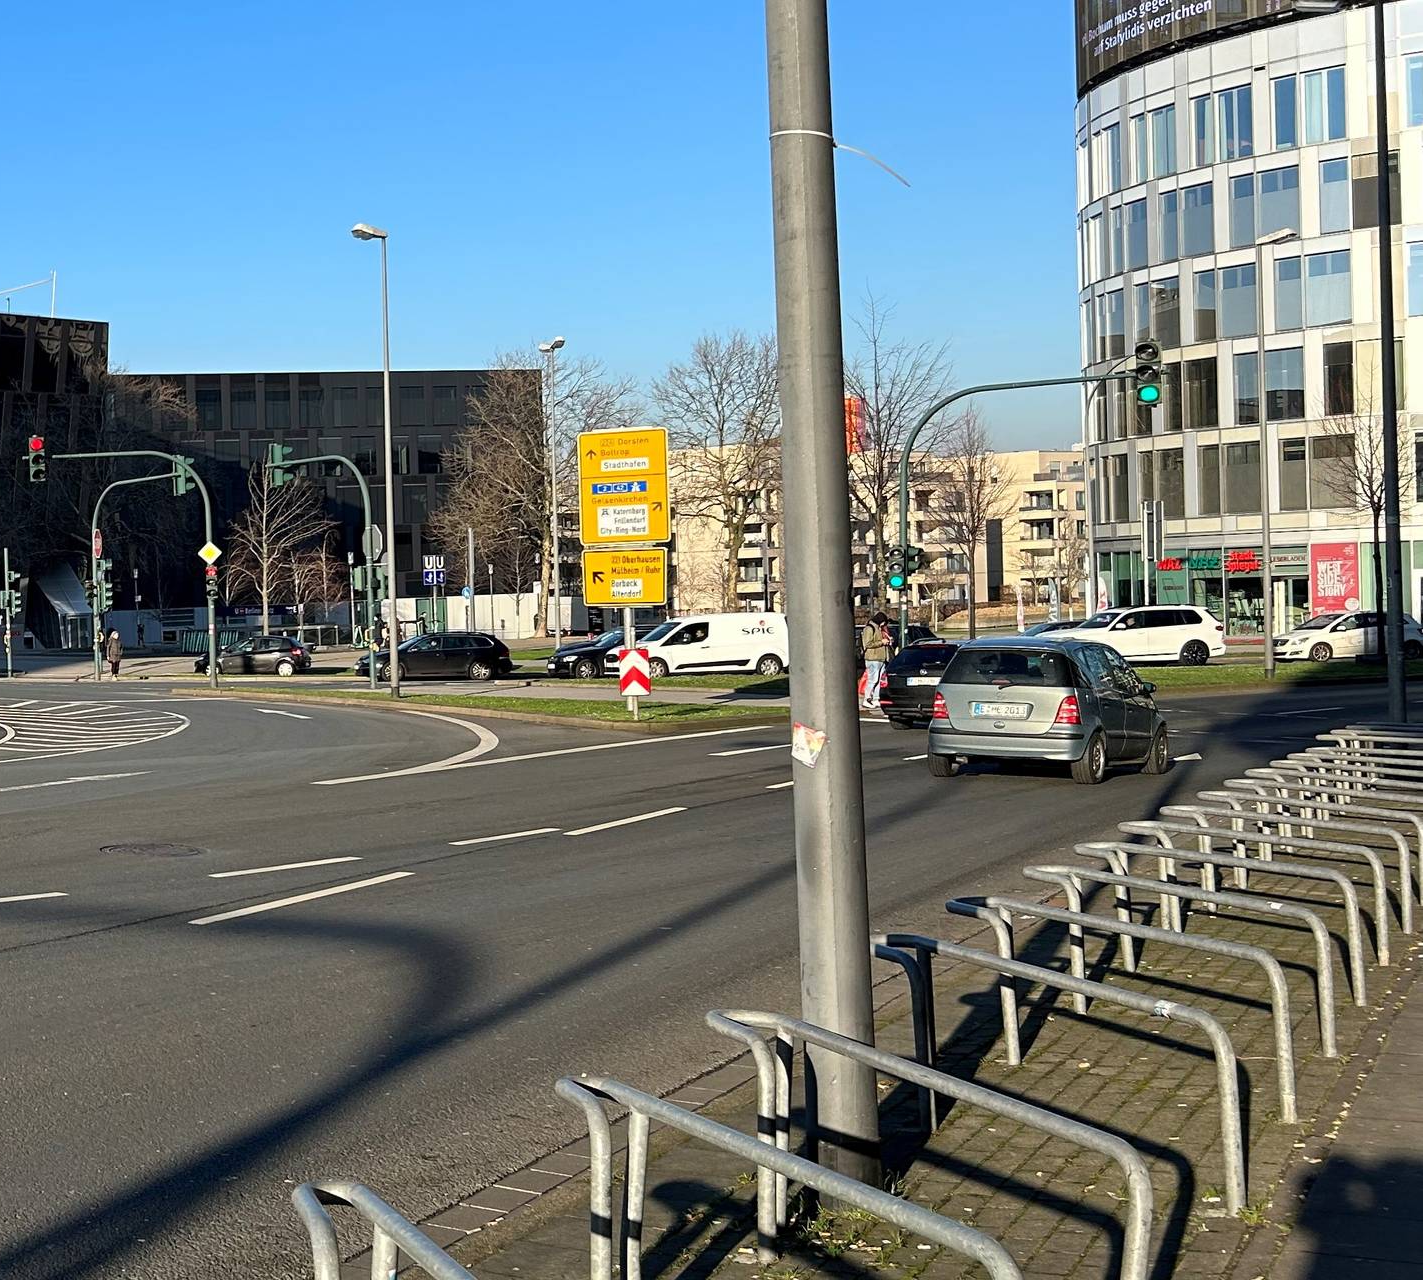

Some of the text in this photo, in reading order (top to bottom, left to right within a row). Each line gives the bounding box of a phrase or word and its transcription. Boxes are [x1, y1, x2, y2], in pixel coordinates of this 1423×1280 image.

[1088, 19, 1113, 41] Bochum
[1114, 7, 1137, 26] muss
[1094, 0, 1212, 57] auf Stafylidis verzichten
[618, 438, 649, 446] Dorsten
[600, 449, 629, 457] Bottrop
[603, 461, 647, 470] Stadthafen
[591, 496, 649, 505] Gelsenkirchen
[613, 508, 646, 516] Katernberg
[614, 517, 646, 525] Frillendorf
[600, 526, 647, 535] City-Ring-Nord
[1228, 550, 1256, 560] Stadt
[425, 556, 444, 569] U U
[622, 556, 661, 564] Oberhausen
[1157, 557, 1183, 570] WAZ
[1226, 560, 1261, 574] Spiegel
[1317, 561, 1342, 573] WEST
[611, 567, 639, 575] Mülheim
[611, 579, 637, 587] Borbeck
[1318, 573, 1342, 585] SIDE
[612, 590, 641, 598] Altendorf
[1318, 584, 1346, 596] STORY
[742, 627, 775, 635] SPIE
